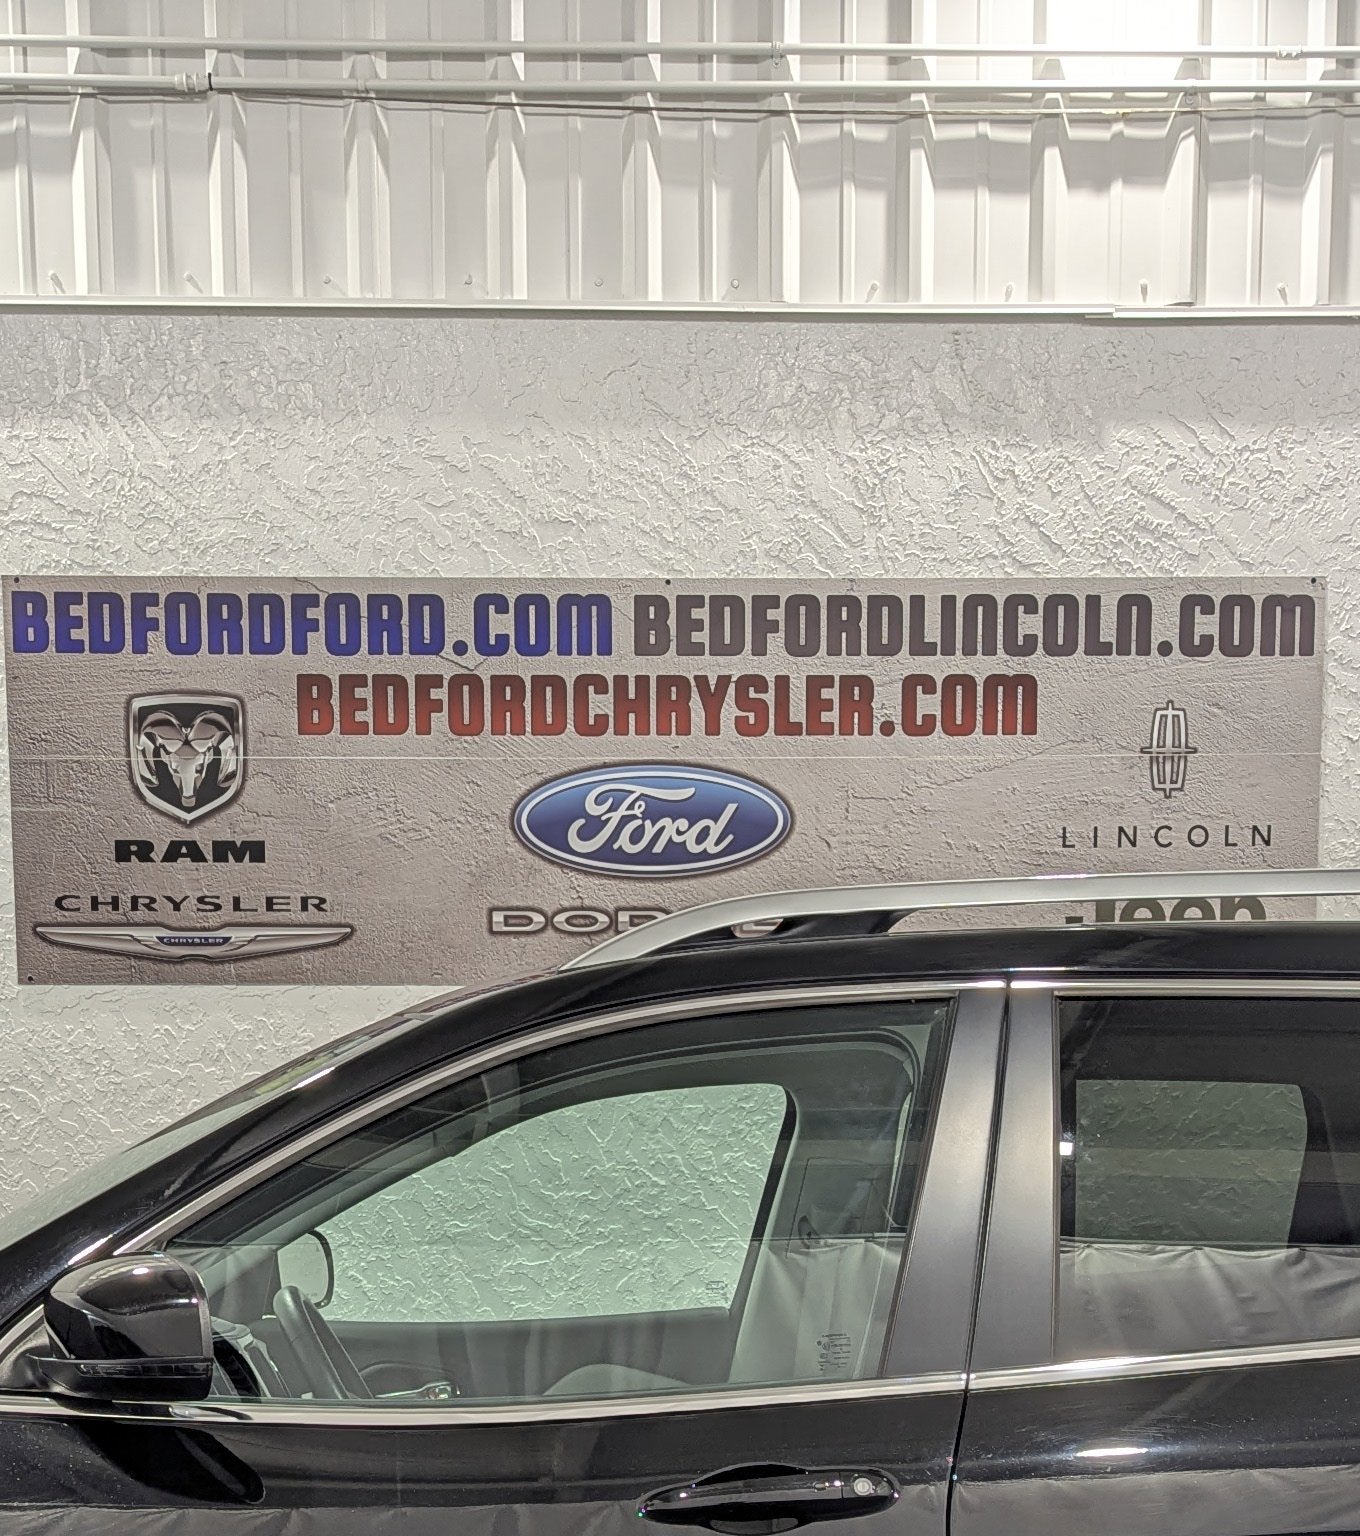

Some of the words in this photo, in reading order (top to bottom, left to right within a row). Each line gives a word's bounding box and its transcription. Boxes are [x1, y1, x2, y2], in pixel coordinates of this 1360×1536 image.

[12, 591, 613, 657] BEDFORDFORD.COM
[633, 594, 1316, 658] BEDFORDLINCOLN.COM
[296, 673, 1038, 737] BEDFORDCHRYSLER.COM
[567, 783, 739, 854] Ford
[1061, 824, 1274, 850] LINCOLN
[114, 839, 267, 863] RAM
[53, 894, 329, 913] CHRYSLER
[162, 937, 224, 945] CHRYSLER
